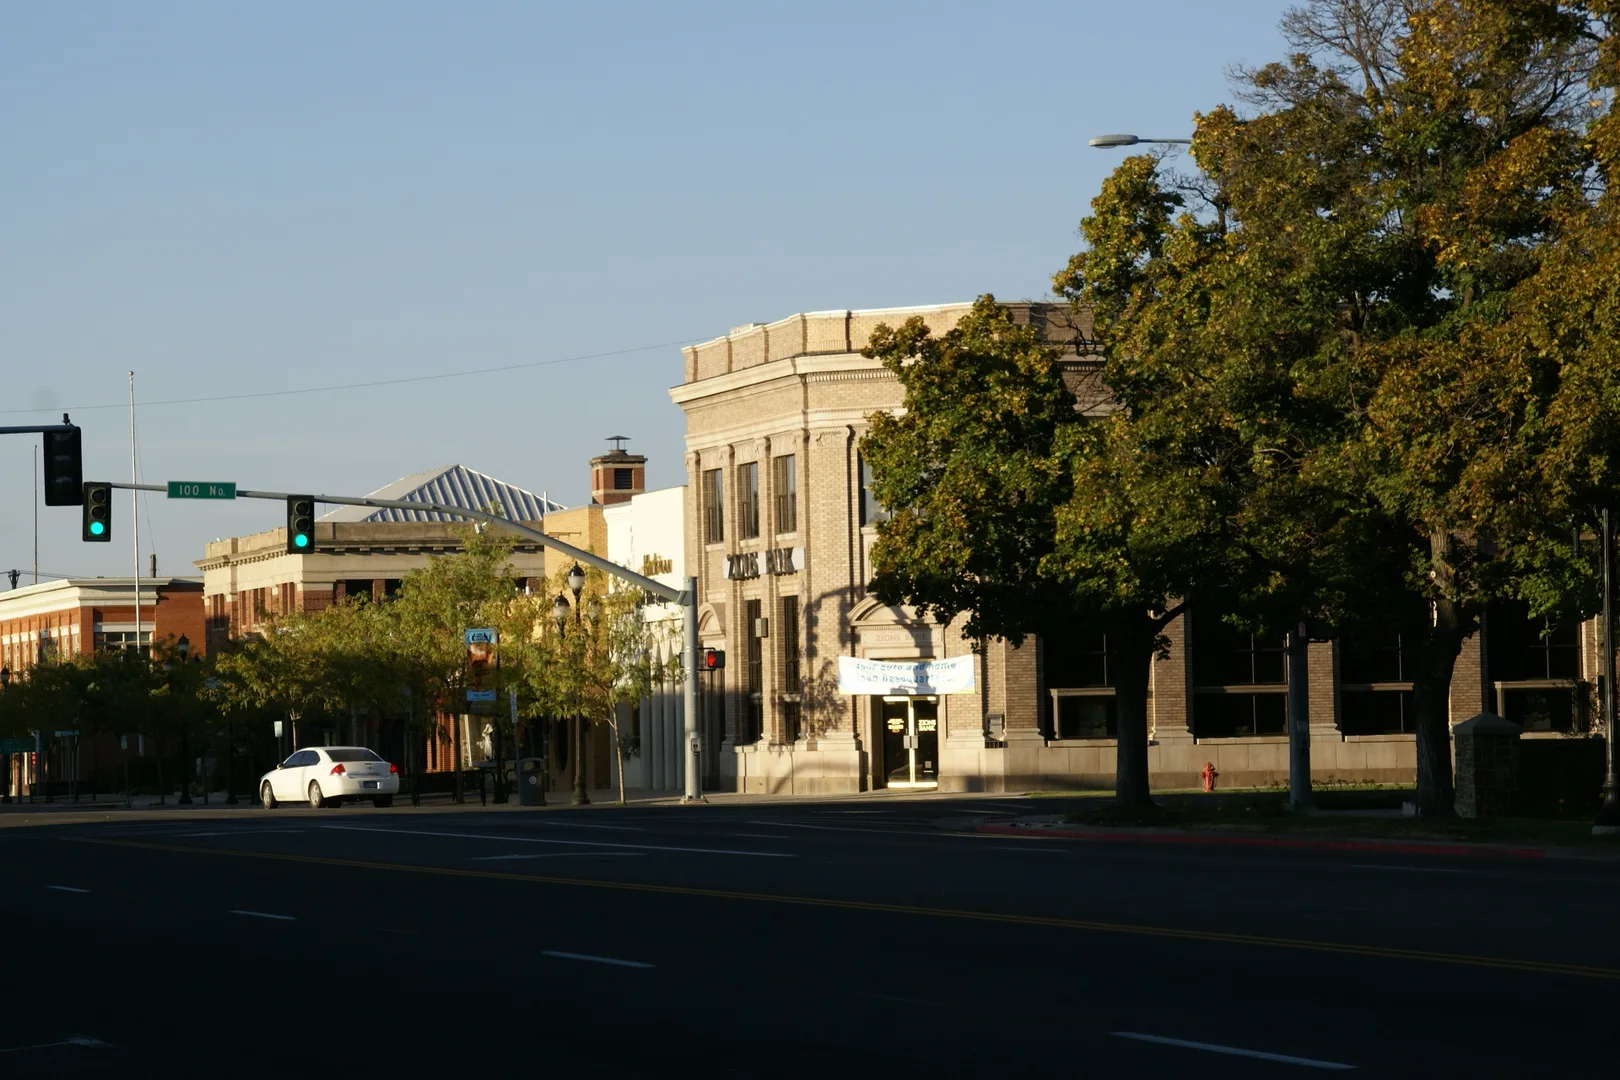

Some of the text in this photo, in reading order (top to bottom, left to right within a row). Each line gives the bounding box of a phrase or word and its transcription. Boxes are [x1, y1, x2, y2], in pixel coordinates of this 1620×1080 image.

[179, 485, 226, 497] 100 No.
[727, 547, 798, 581] ZIONS BANK
[875, 633, 928, 642] ZIONS BANK
[906, 663, 926, 671] and
[928, 662, 957, 670] home
